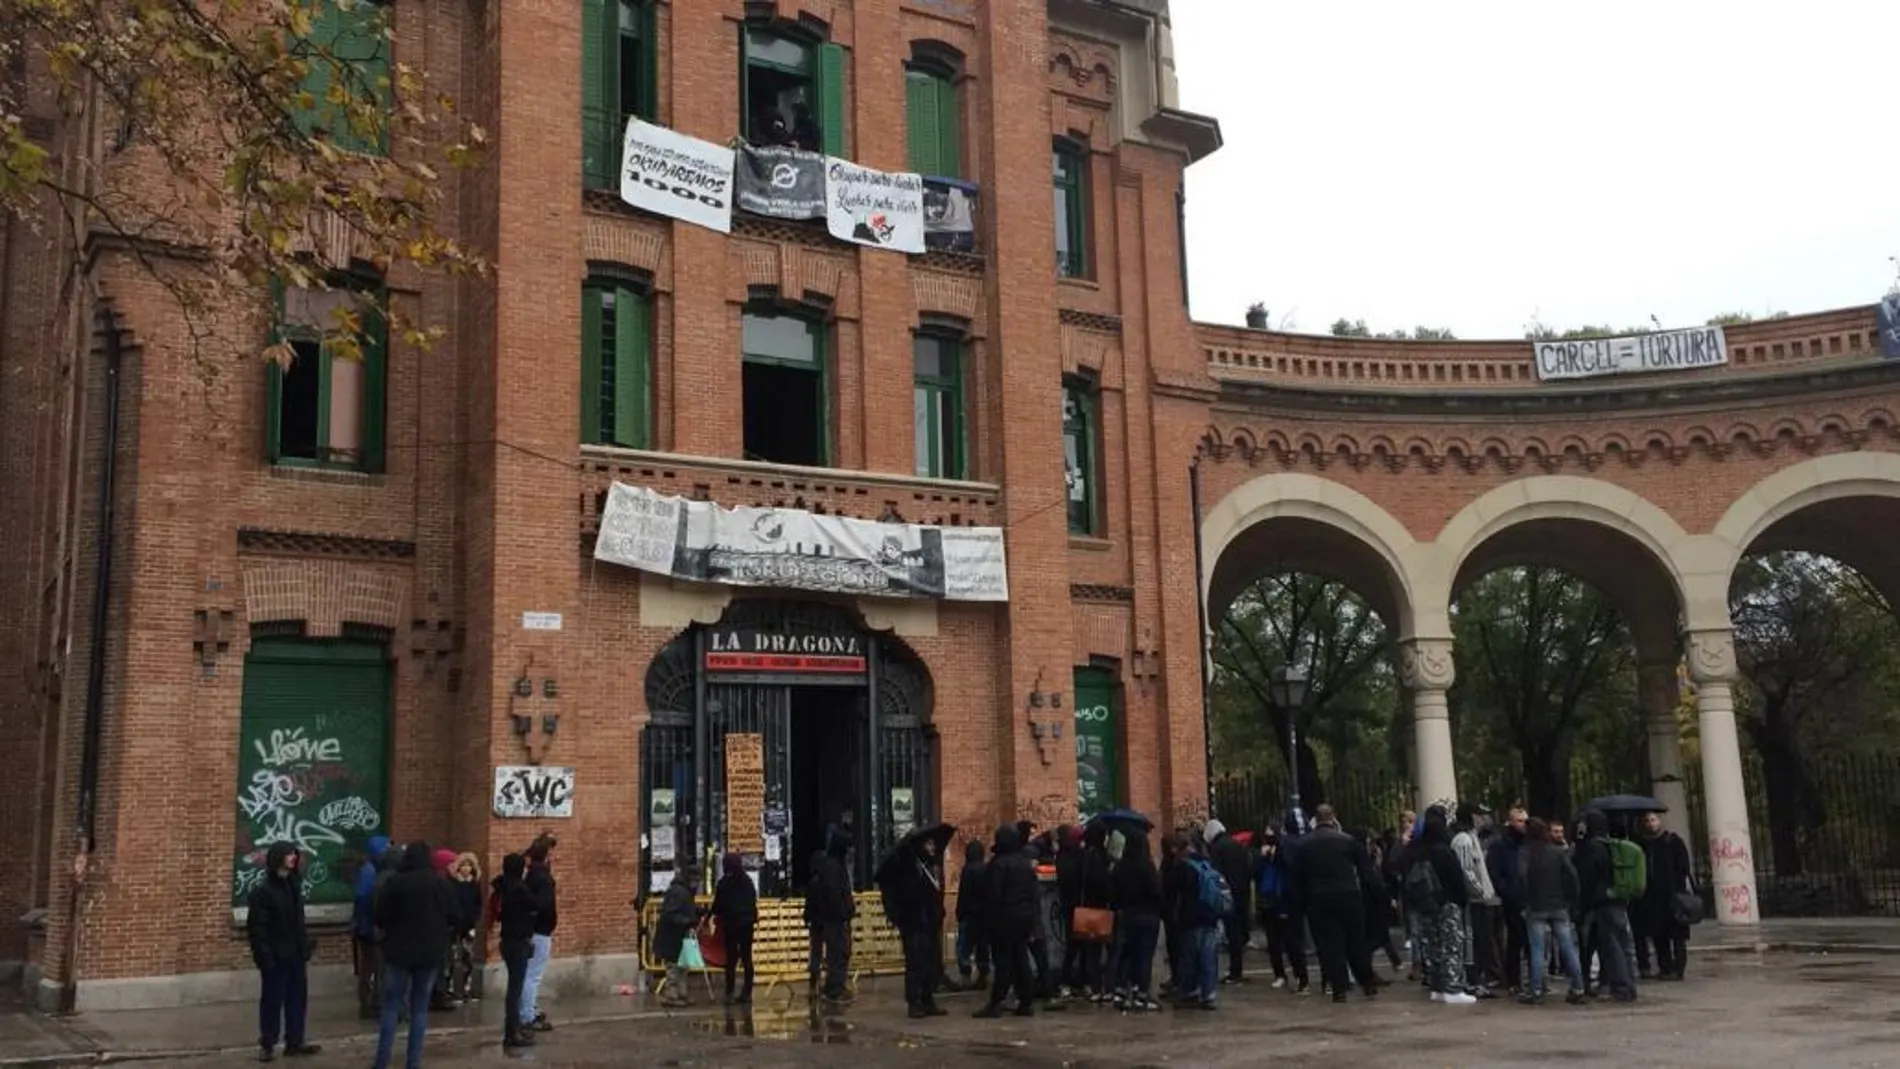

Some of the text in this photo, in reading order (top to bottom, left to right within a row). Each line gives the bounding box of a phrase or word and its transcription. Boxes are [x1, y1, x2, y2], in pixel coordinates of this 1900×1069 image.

[625, 170, 724, 208] 1000
[1540, 340, 1618, 374] CARCEL
[1640, 329, 1722, 368] TORTURA
[712, 631, 860, 655] LA DRAGONA
[522, 775, 567, 808] WC
